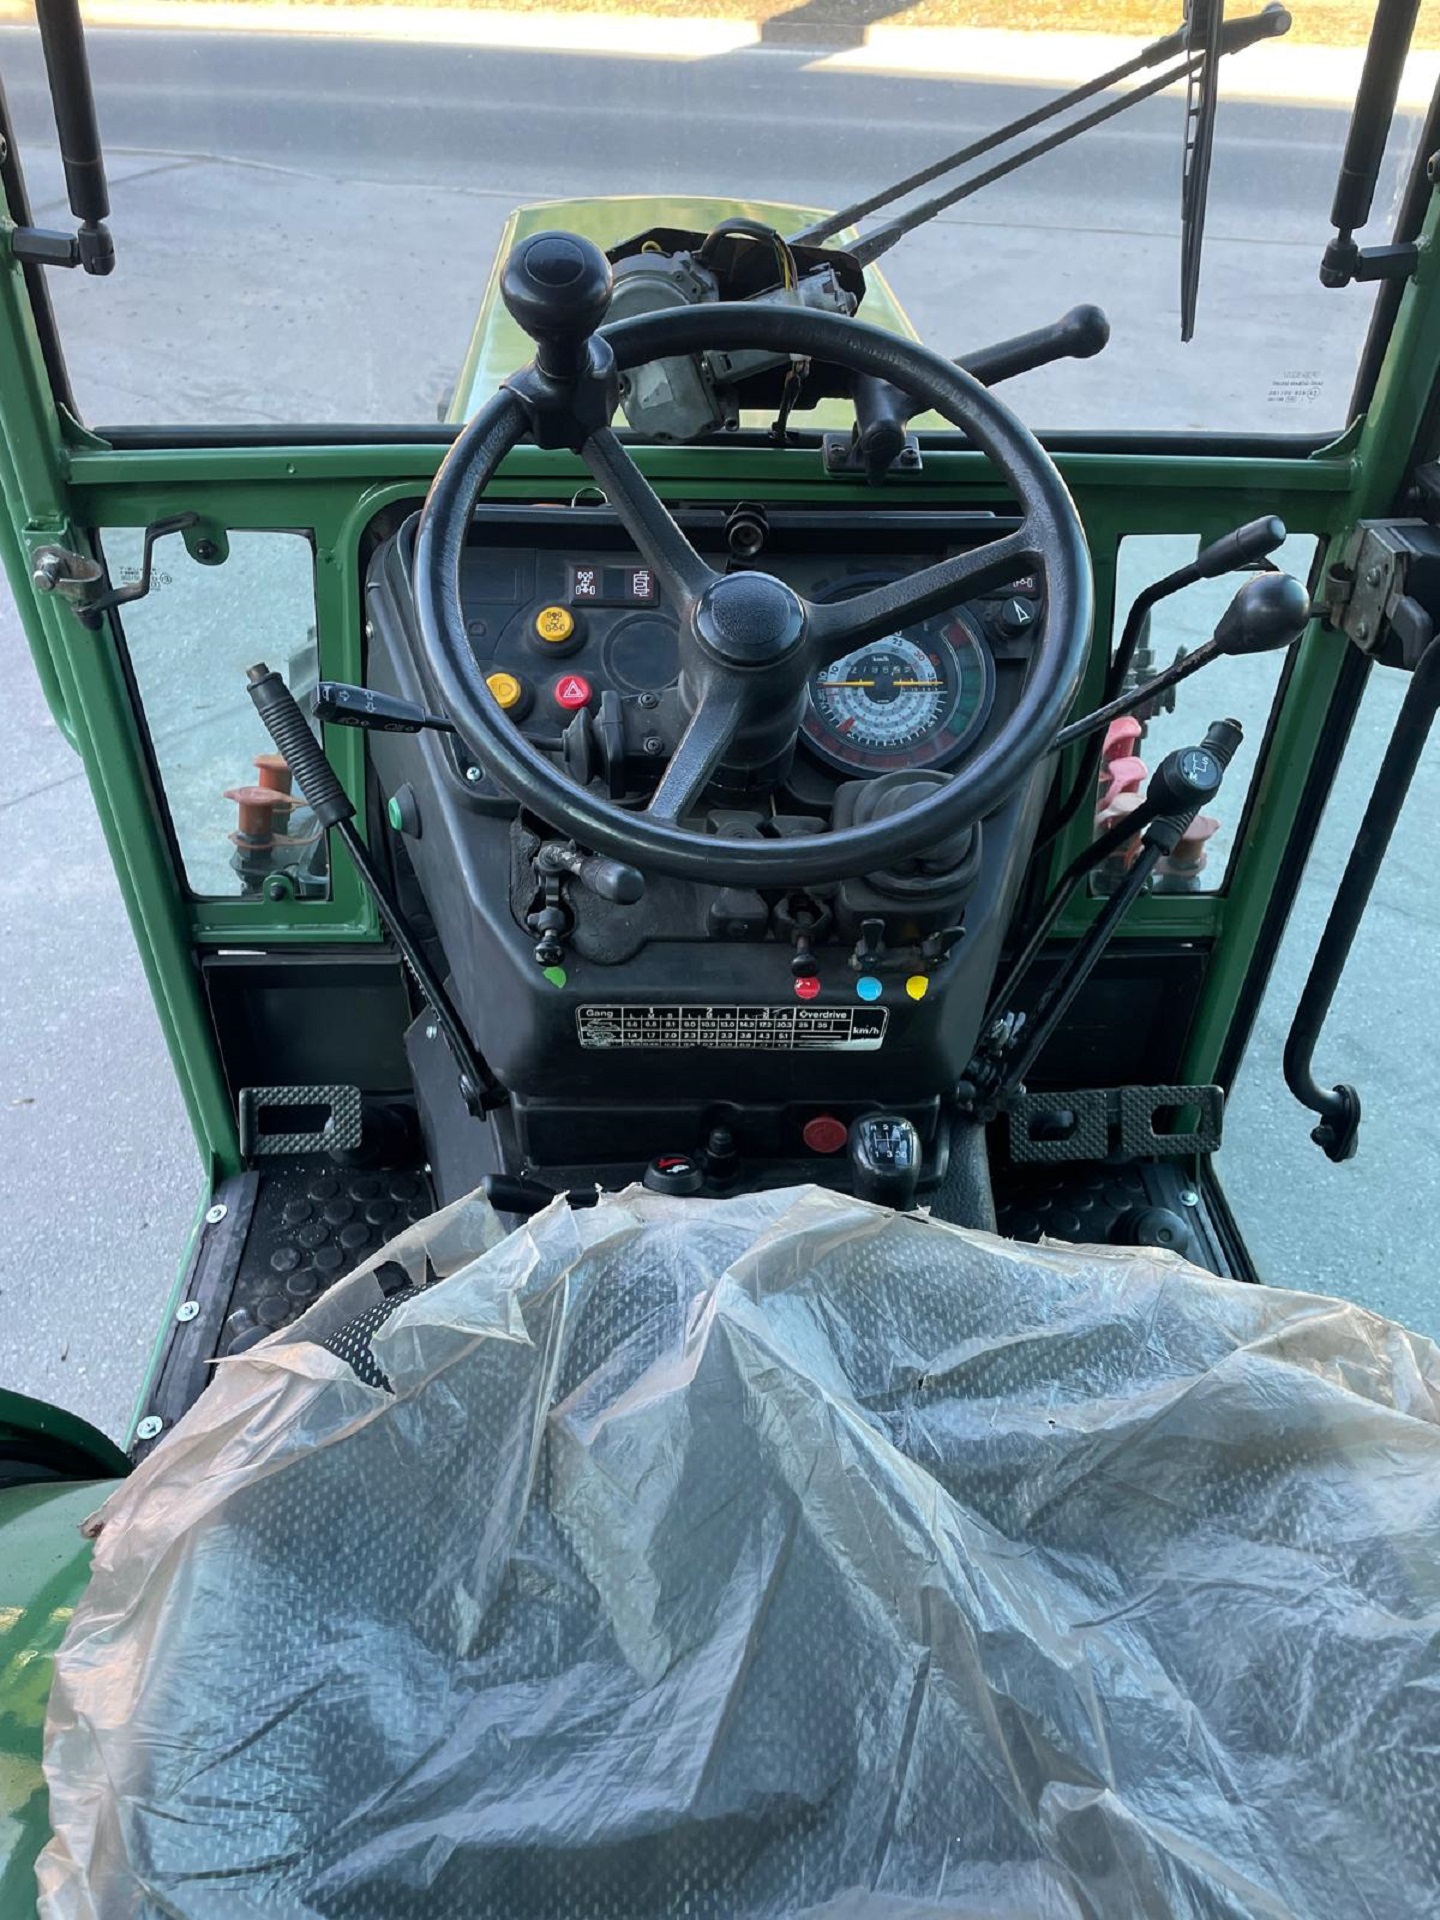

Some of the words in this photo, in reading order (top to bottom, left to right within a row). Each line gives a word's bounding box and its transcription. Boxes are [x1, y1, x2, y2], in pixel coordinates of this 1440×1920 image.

[913, 649, 926, 662] 30
[585, 1008, 614, 1019] Gang
[799, 1010, 848, 1019] Overdrive
[852, 1026, 880, 1035] km/h
